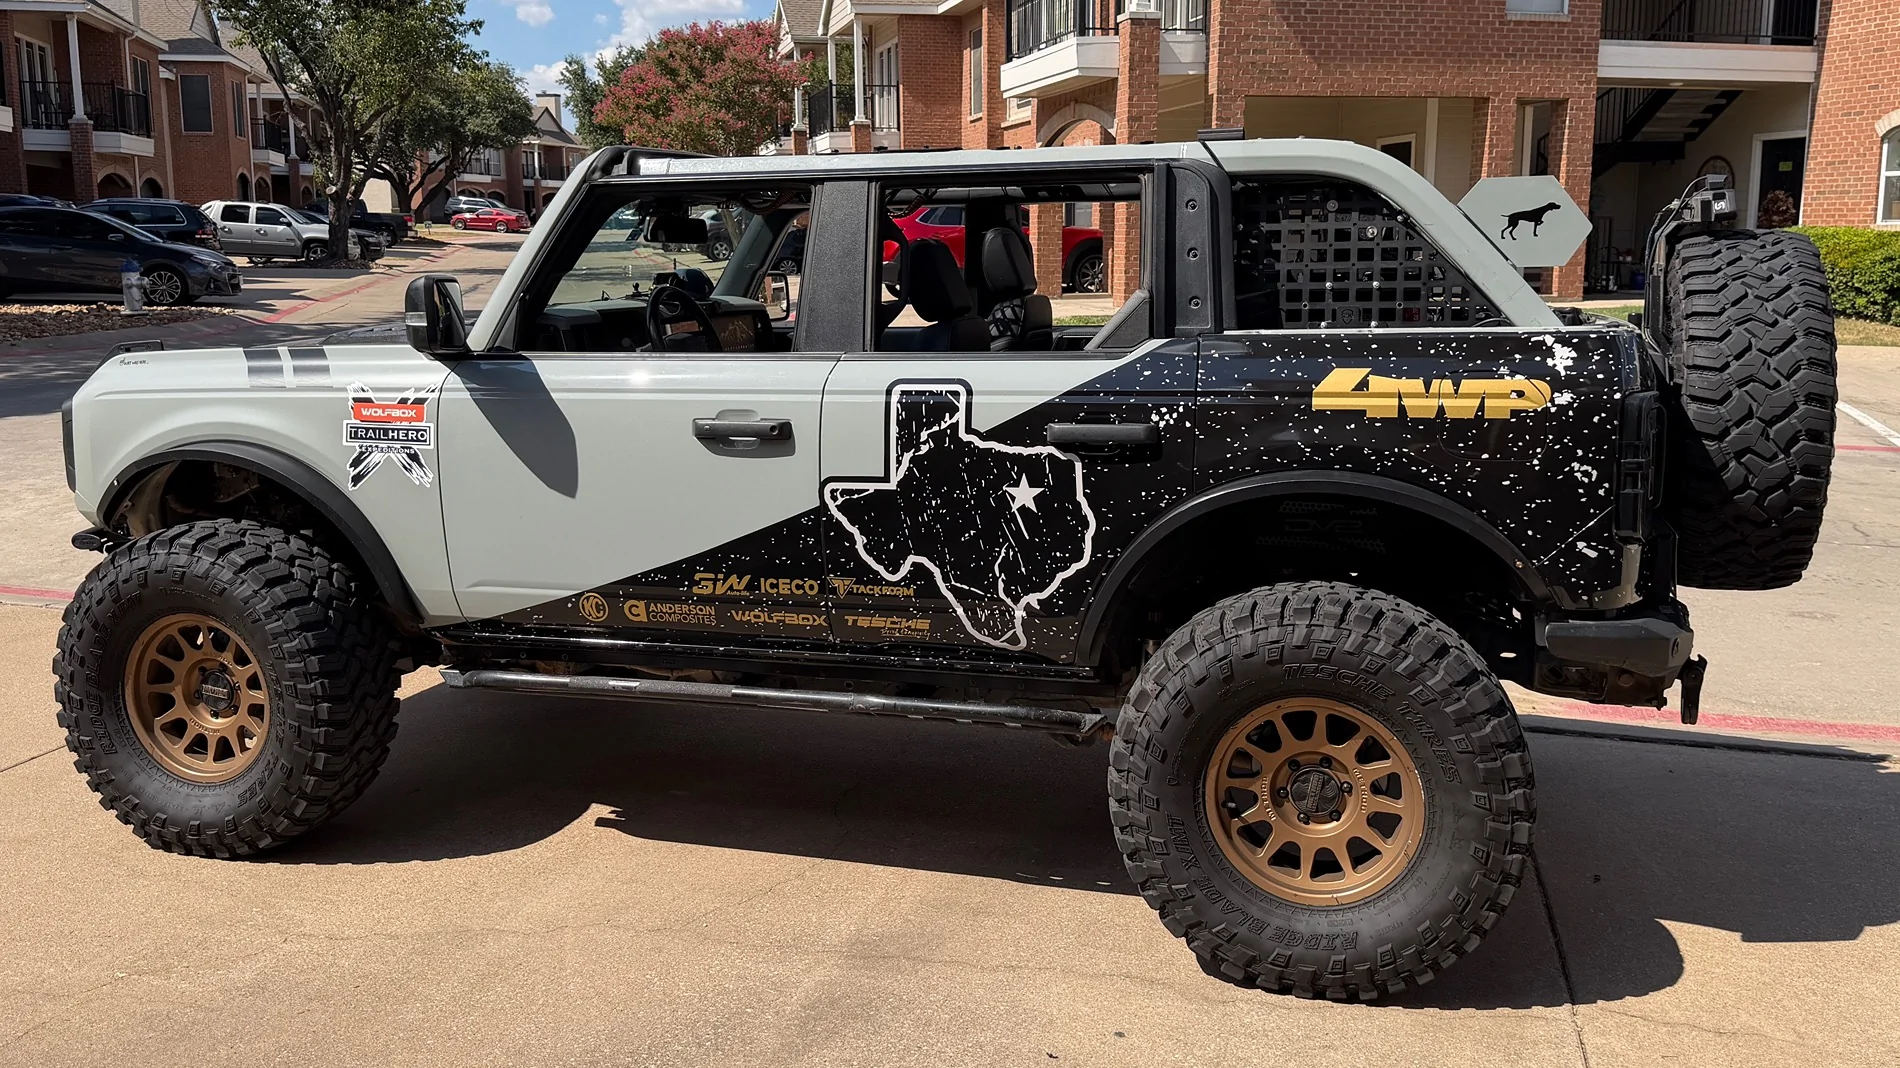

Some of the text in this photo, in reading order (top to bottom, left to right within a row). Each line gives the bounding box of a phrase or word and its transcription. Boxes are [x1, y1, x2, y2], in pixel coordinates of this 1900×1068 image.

[1312, 367, 1552, 419] 4WP
[360, 407, 417, 418] WOLFBOX
[349, 427, 428, 442] TRAILHERO
[361, 446, 416, 455] EXPEDITIONS
[760, 577, 819, 595] ICECO
[853, 585, 914, 597] TACKFORM
[648, 603, 716, 615] ANDERSON
[649, 612, 717, 624] COMPOSITES
[730, 609, 828, 627] WOLFBOX
[844, 614, 932, 629] TESCHE
[1282, 663, 1463, 784] TESCHE TIRES
[1193, 873, 1271, 936] BLADE
[1266, 926, 1358, 951] RIDGE
